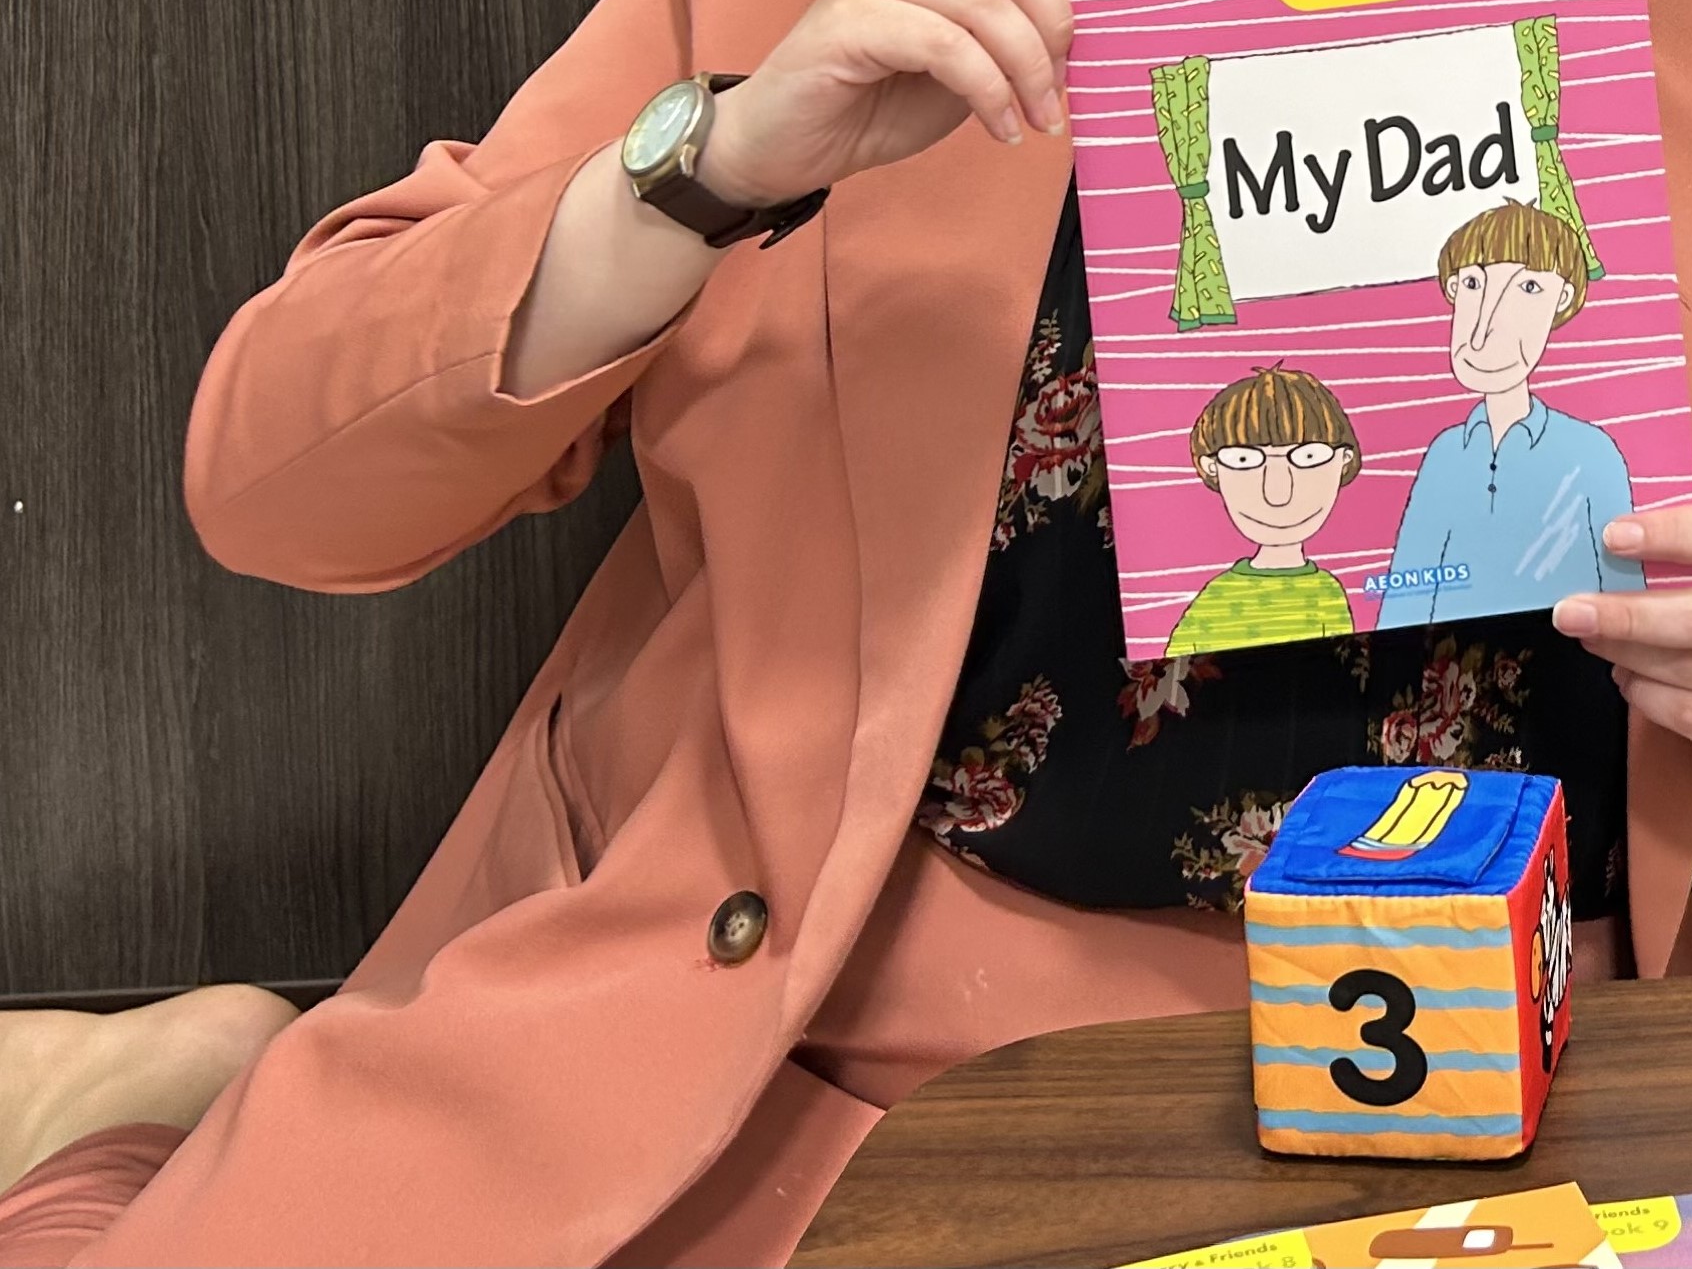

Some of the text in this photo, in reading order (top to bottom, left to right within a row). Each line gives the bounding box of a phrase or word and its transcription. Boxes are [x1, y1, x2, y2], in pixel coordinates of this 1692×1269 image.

[1222, 102, 1520, 234] My Dad
[1364, 564, 1471, 592] AEON KIDS
[1328, 968, 1428, 1106] 3
[1594, 1206, 1651, 1220] riends
[1652, 1219, 1669, 1231] 9
[1209, 1242, 1278, 1264] Friends
